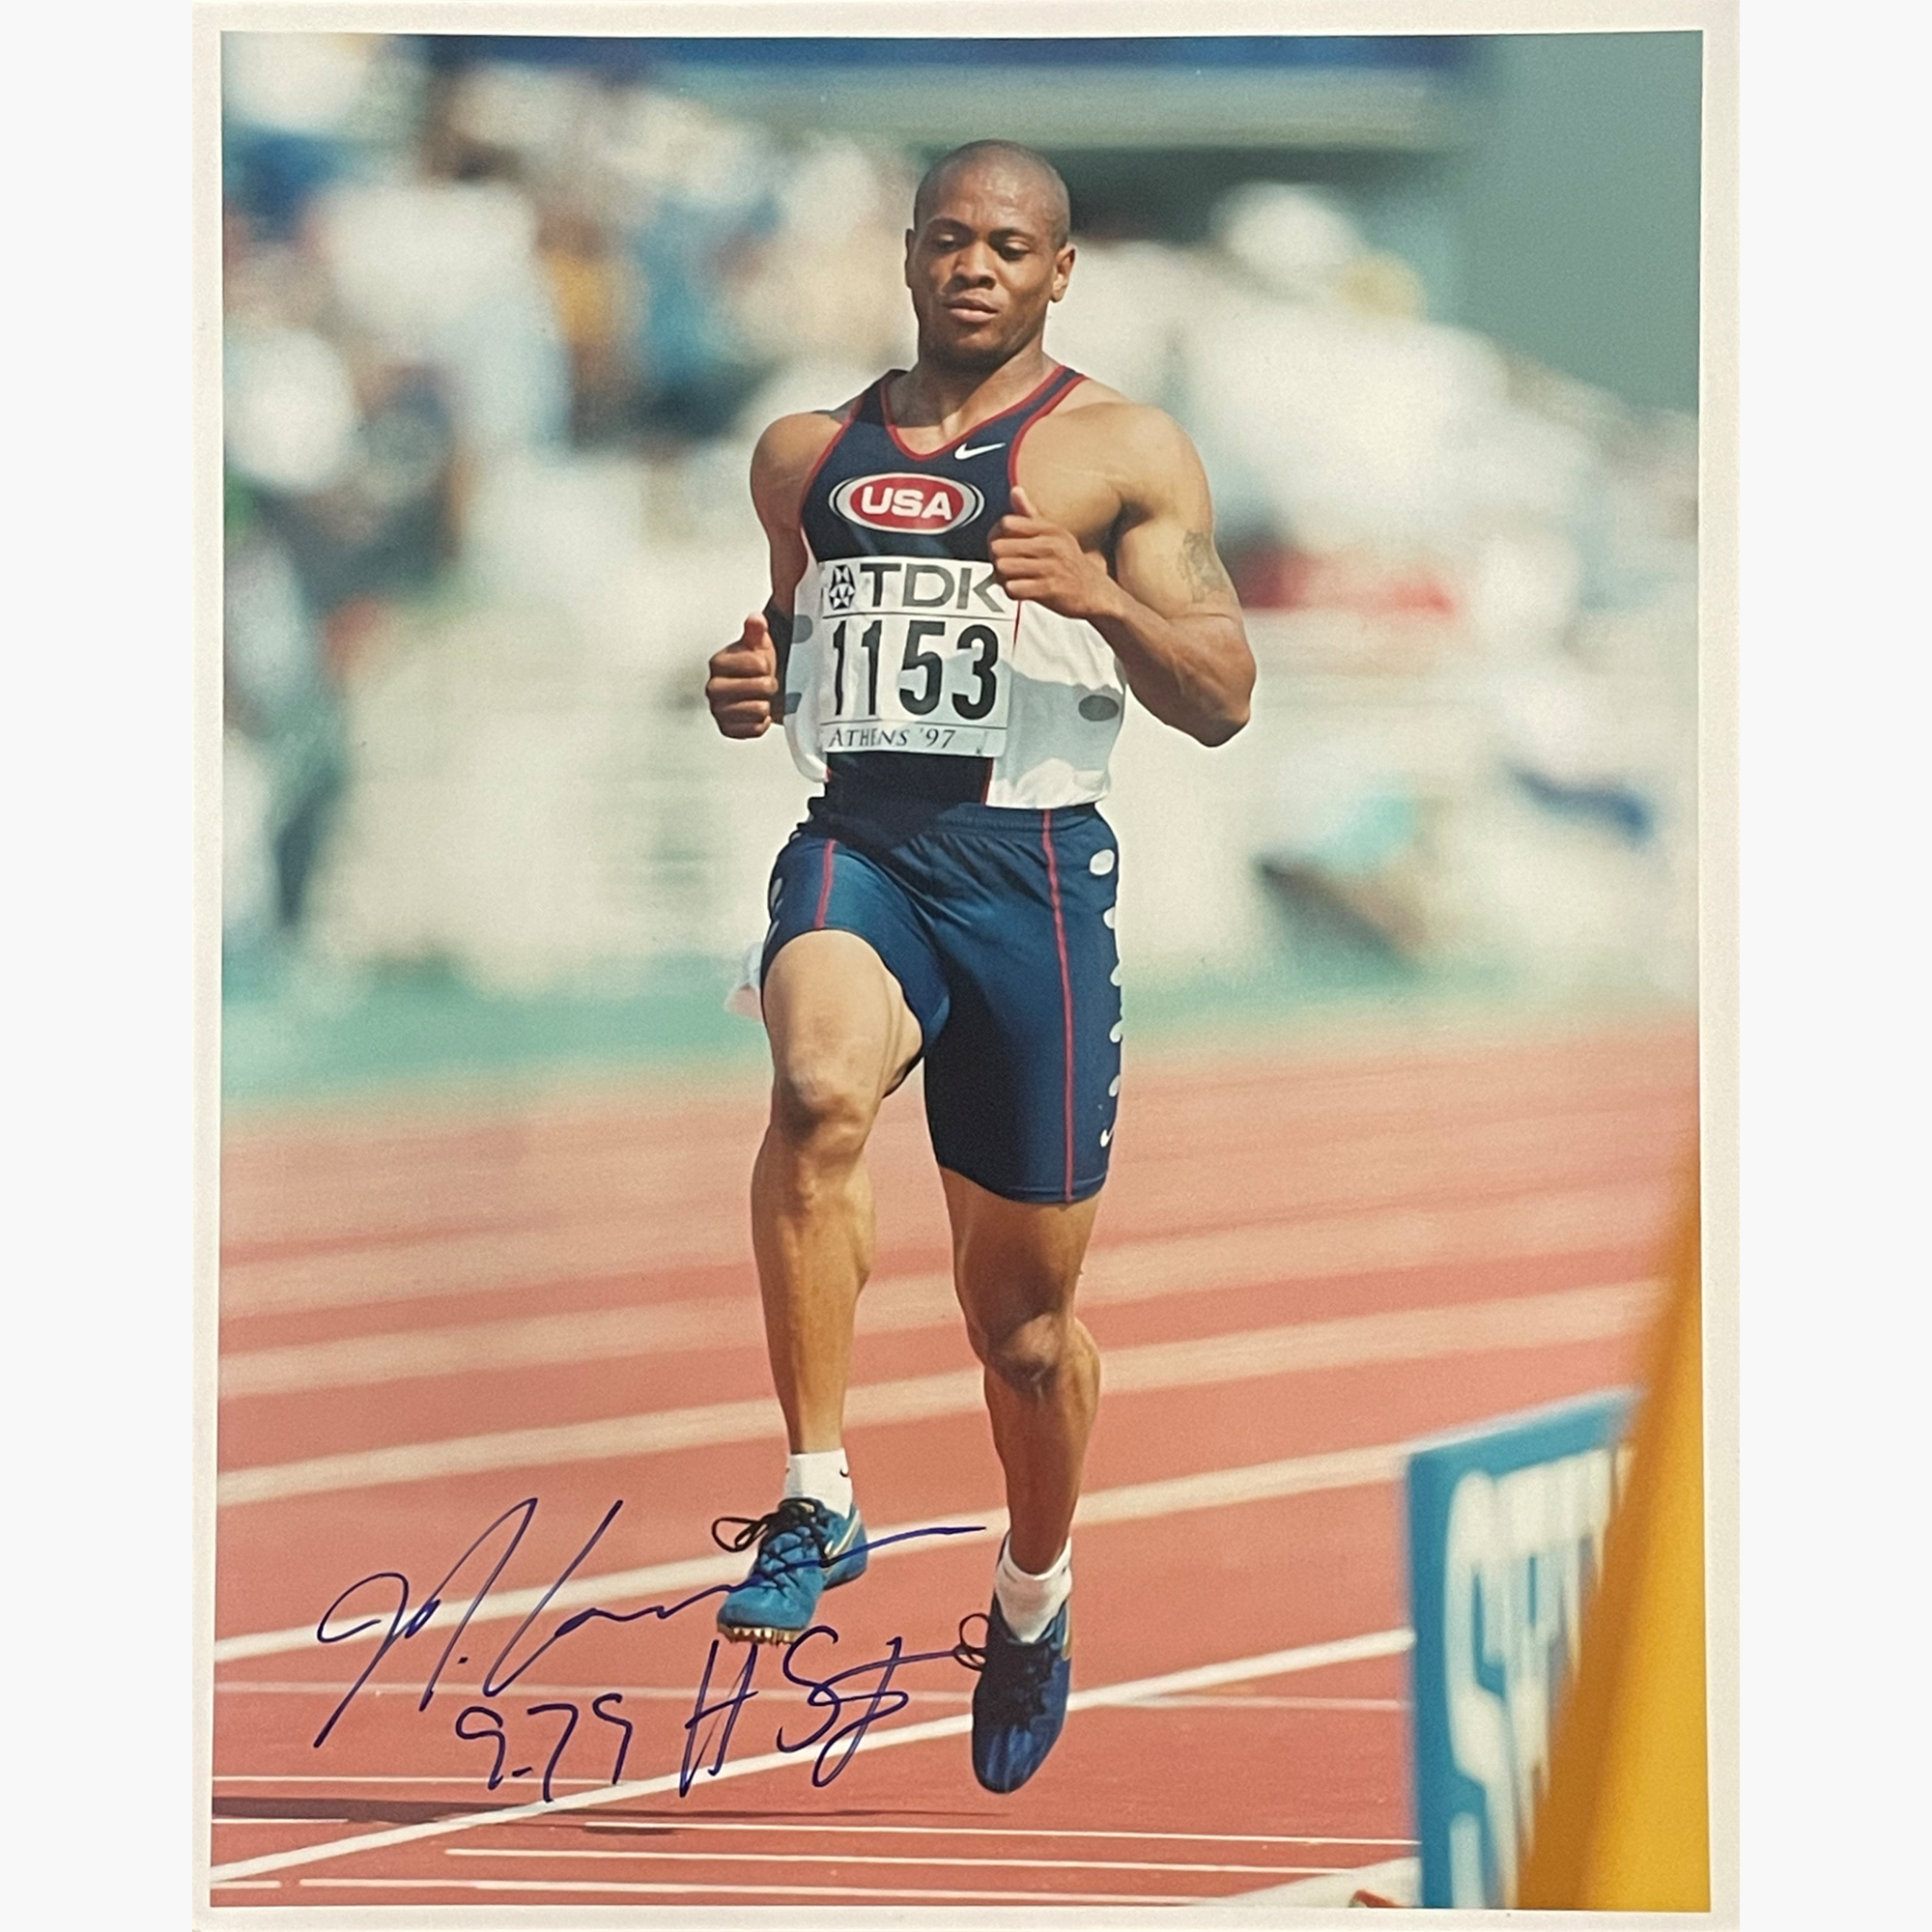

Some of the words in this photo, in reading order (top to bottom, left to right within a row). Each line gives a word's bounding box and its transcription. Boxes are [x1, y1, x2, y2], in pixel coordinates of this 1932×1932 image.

[860, 486, 952, 521] USA
[860, 562, 1006, 613] TDK
[833, 619, 1000, 721] 1153
[828, 727, 909, 748] ATHENS
